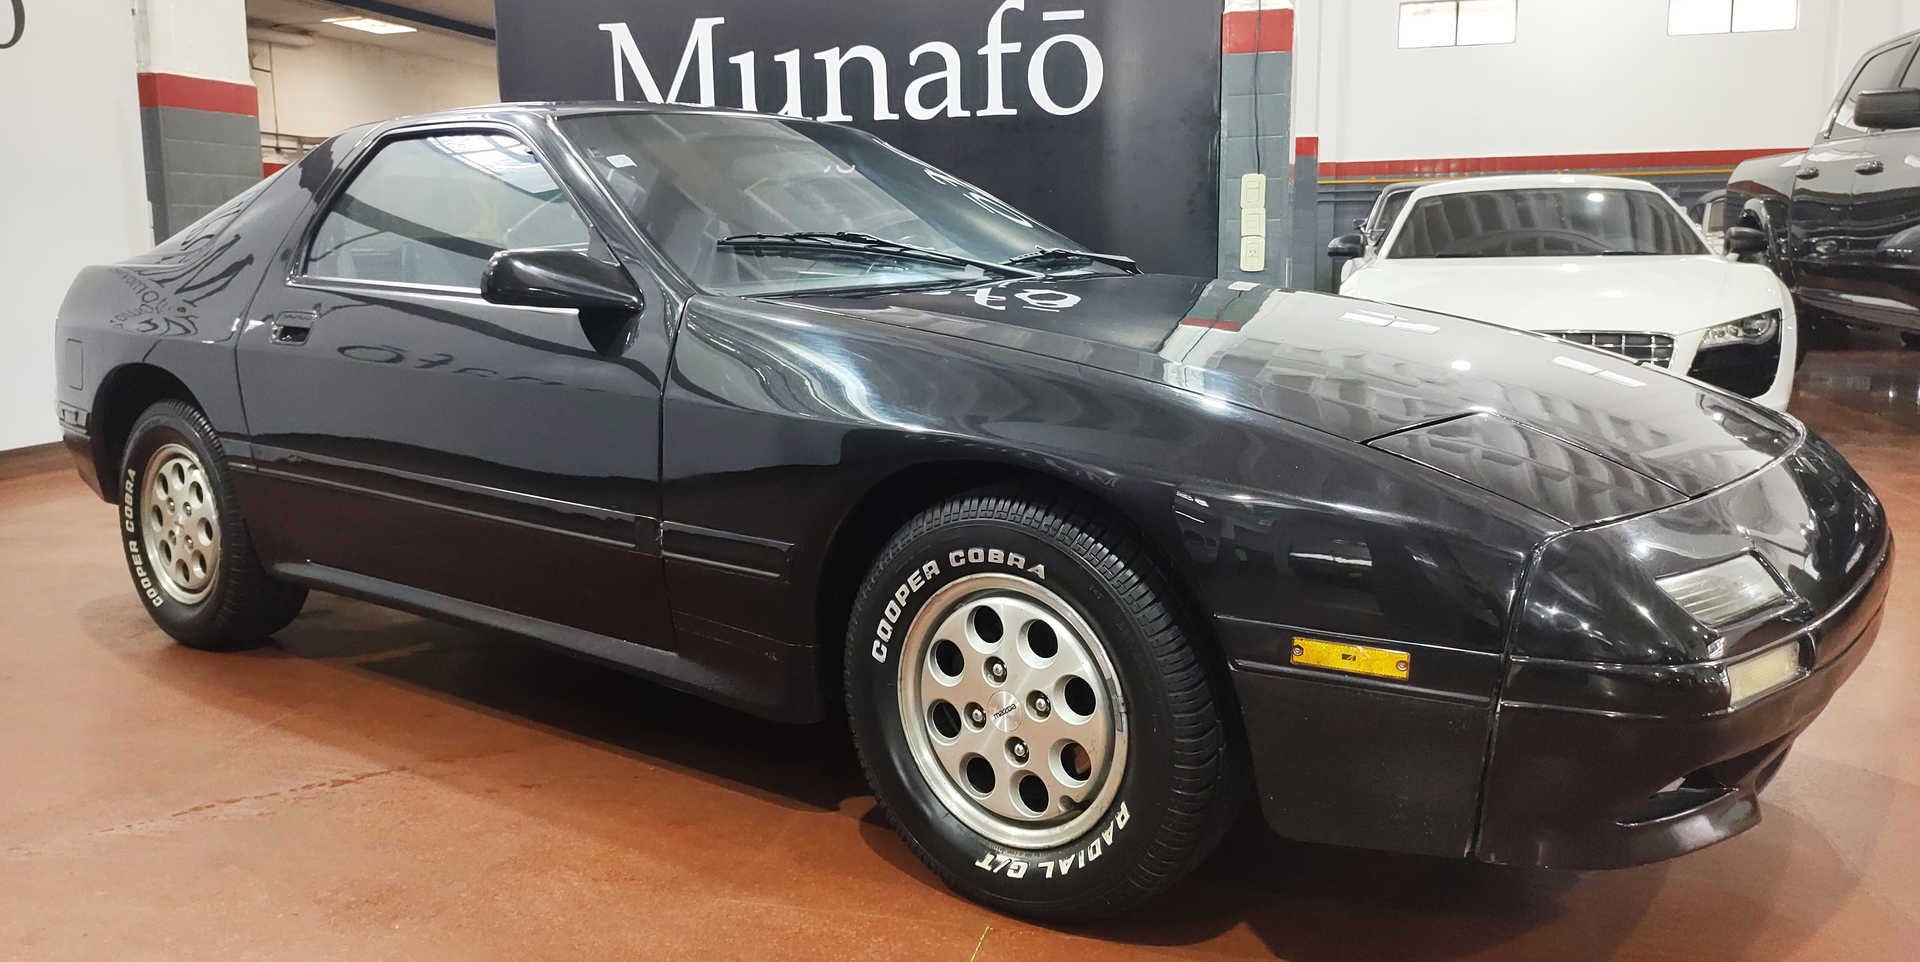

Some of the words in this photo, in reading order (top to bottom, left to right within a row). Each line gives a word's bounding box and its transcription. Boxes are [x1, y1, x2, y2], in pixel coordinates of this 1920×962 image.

[598, 0, 1104, 122] Munafō
[124, 468, 136, 533] COBRA
[128, 540, 164, 608] COOPER
[871, 560, 941, 663] COOPER
[949, 547, 1046, 580] COBRA
[974, 852, 1029, 879] G/T
[1037, 801, 1130, 879] RADIAL
